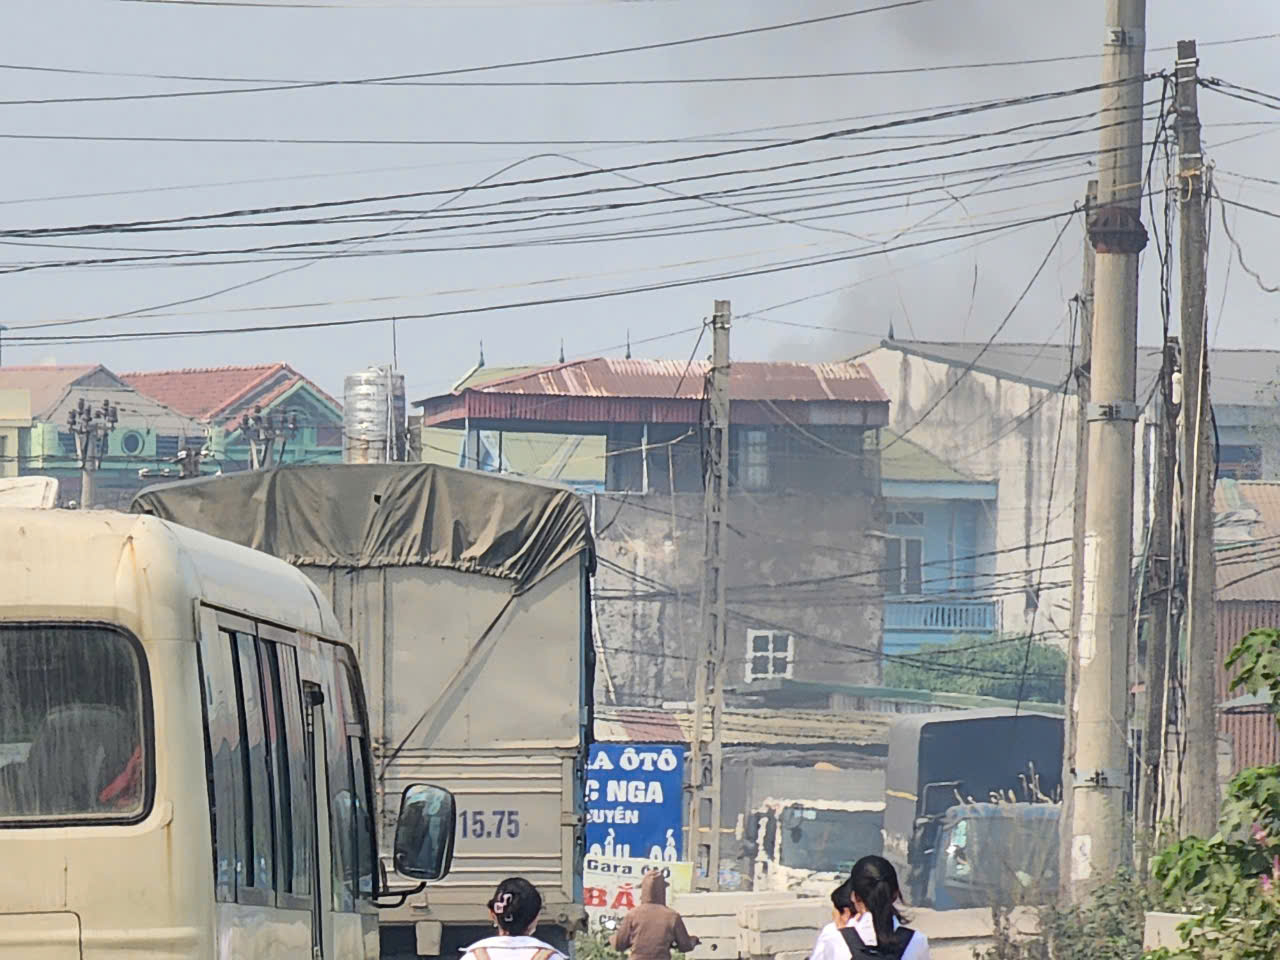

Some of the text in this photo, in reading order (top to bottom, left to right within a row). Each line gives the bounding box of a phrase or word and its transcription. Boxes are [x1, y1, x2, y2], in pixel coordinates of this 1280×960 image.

[619, 747, 678, 771] ÔTÔ
[607, 780, 664, 803] NGA
[587, 860, 632, 874] Gara
